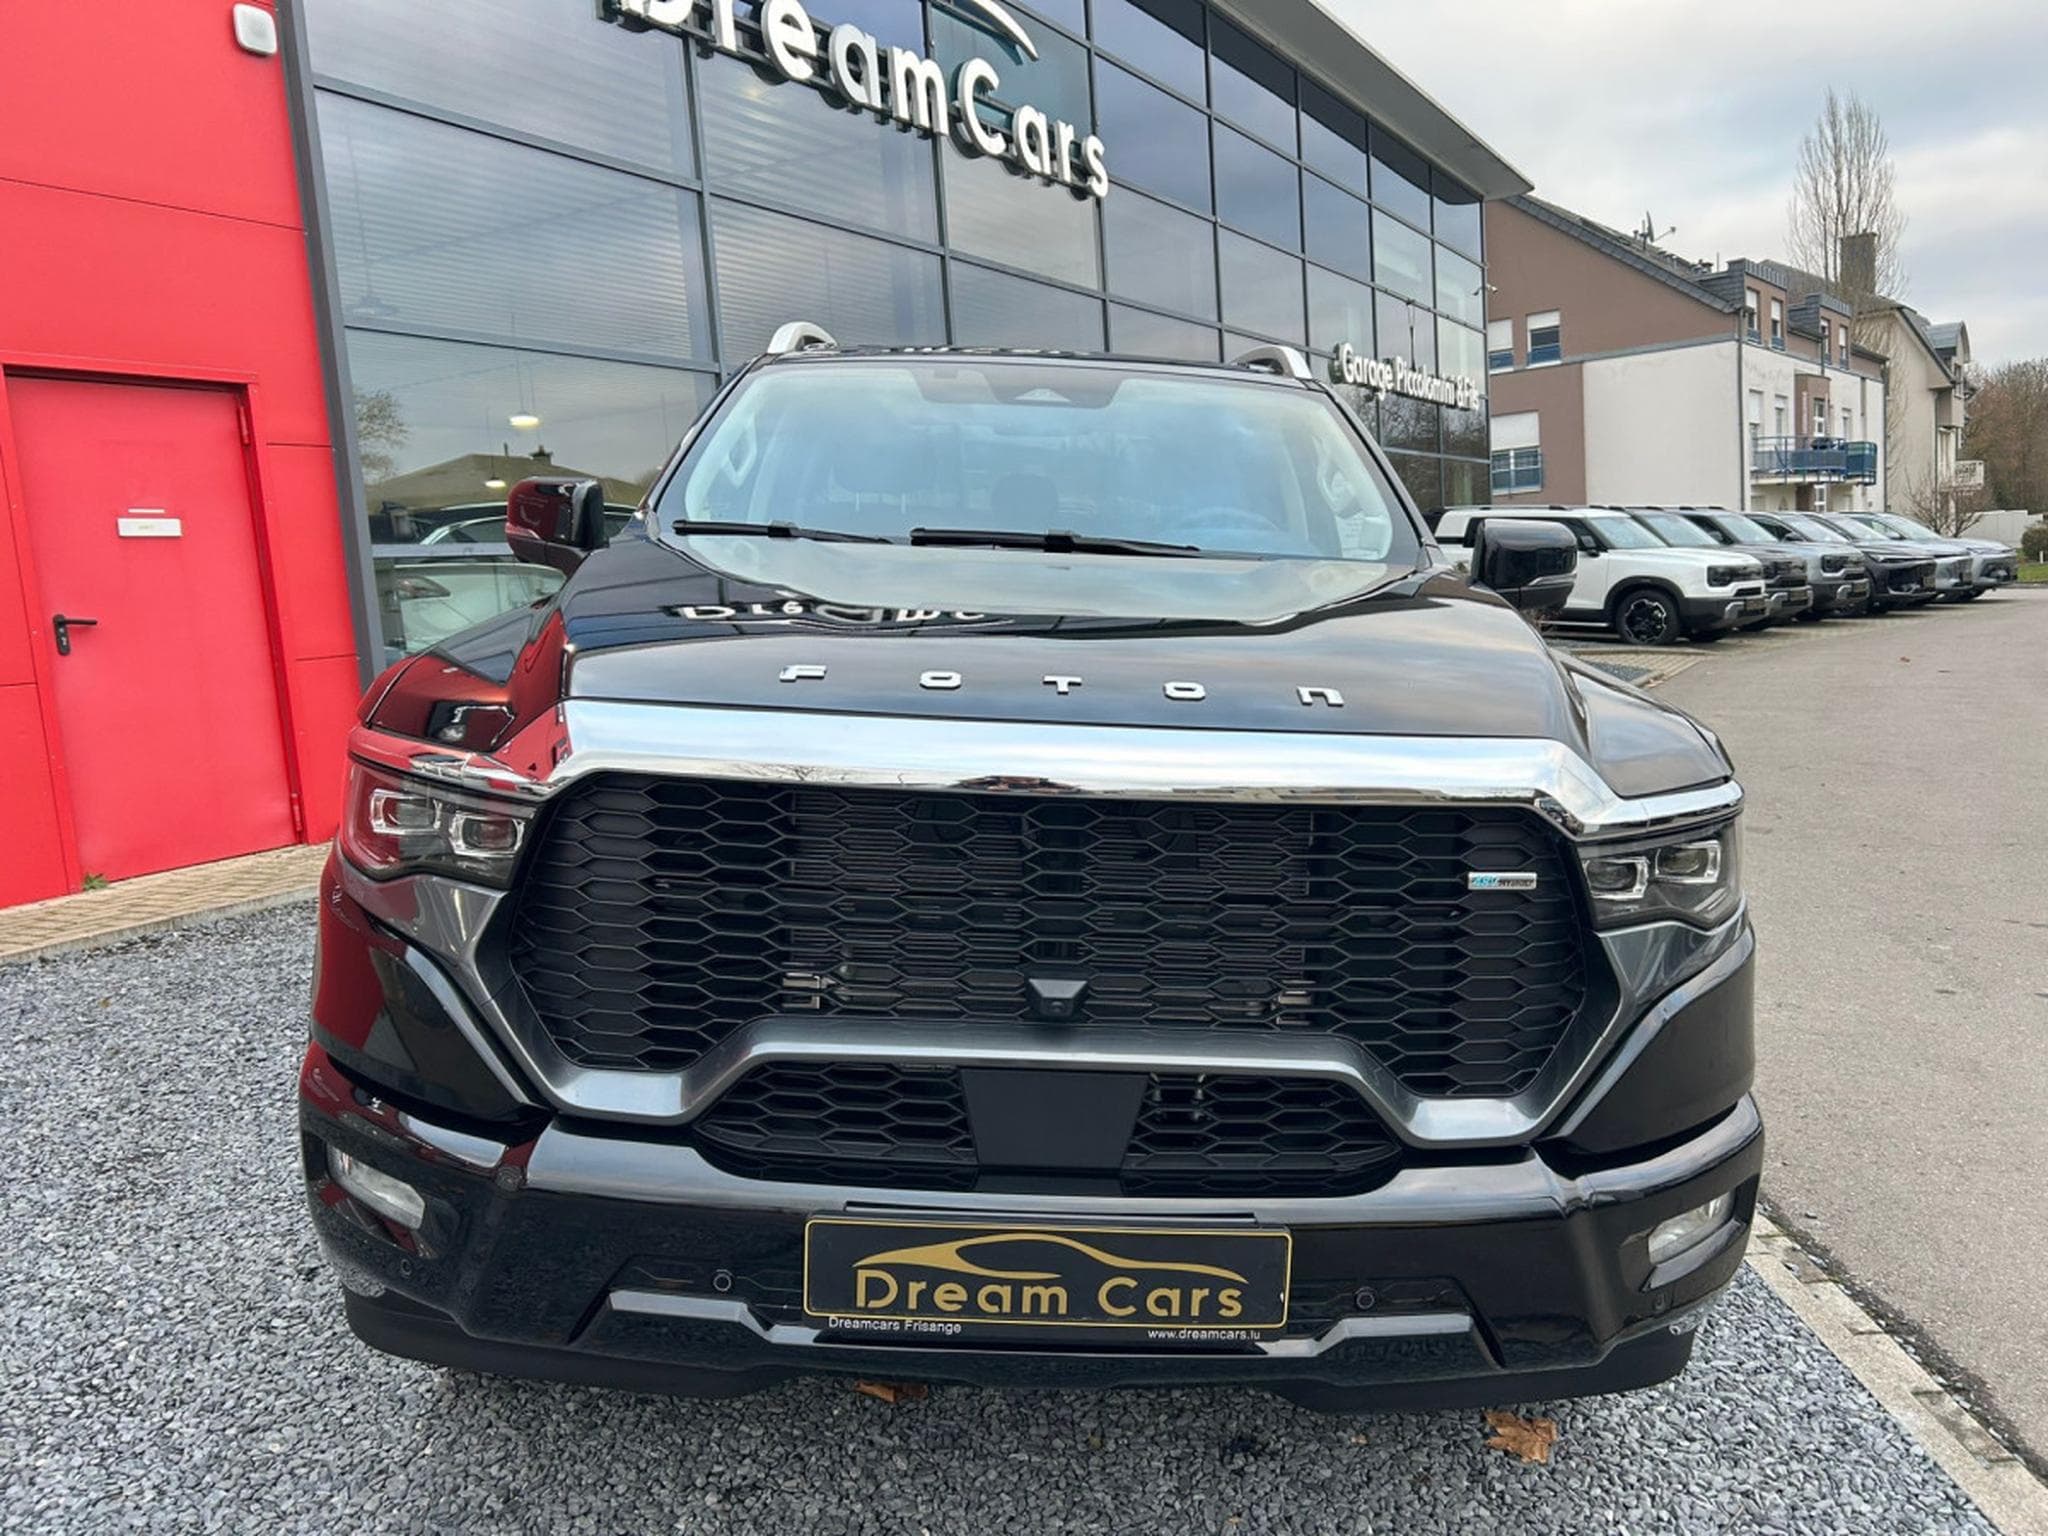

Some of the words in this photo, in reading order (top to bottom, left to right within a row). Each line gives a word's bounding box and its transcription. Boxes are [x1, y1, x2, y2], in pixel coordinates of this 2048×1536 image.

[957, 57, 1108, 198] Cars
[1341, 342, 1393, 400] Garage
[1396, 356, 1455, 406] Piccolomini
[856, 1269, 1069, 1315] Dream
[1097, 1276, 1242, 1317] Cars
[828, 1316, 900, 1331] Dreamcars
[904, 1320, 962, 1335] Frisange
[1147, 1328, 1261, 1340] www.dreamcars.lu
